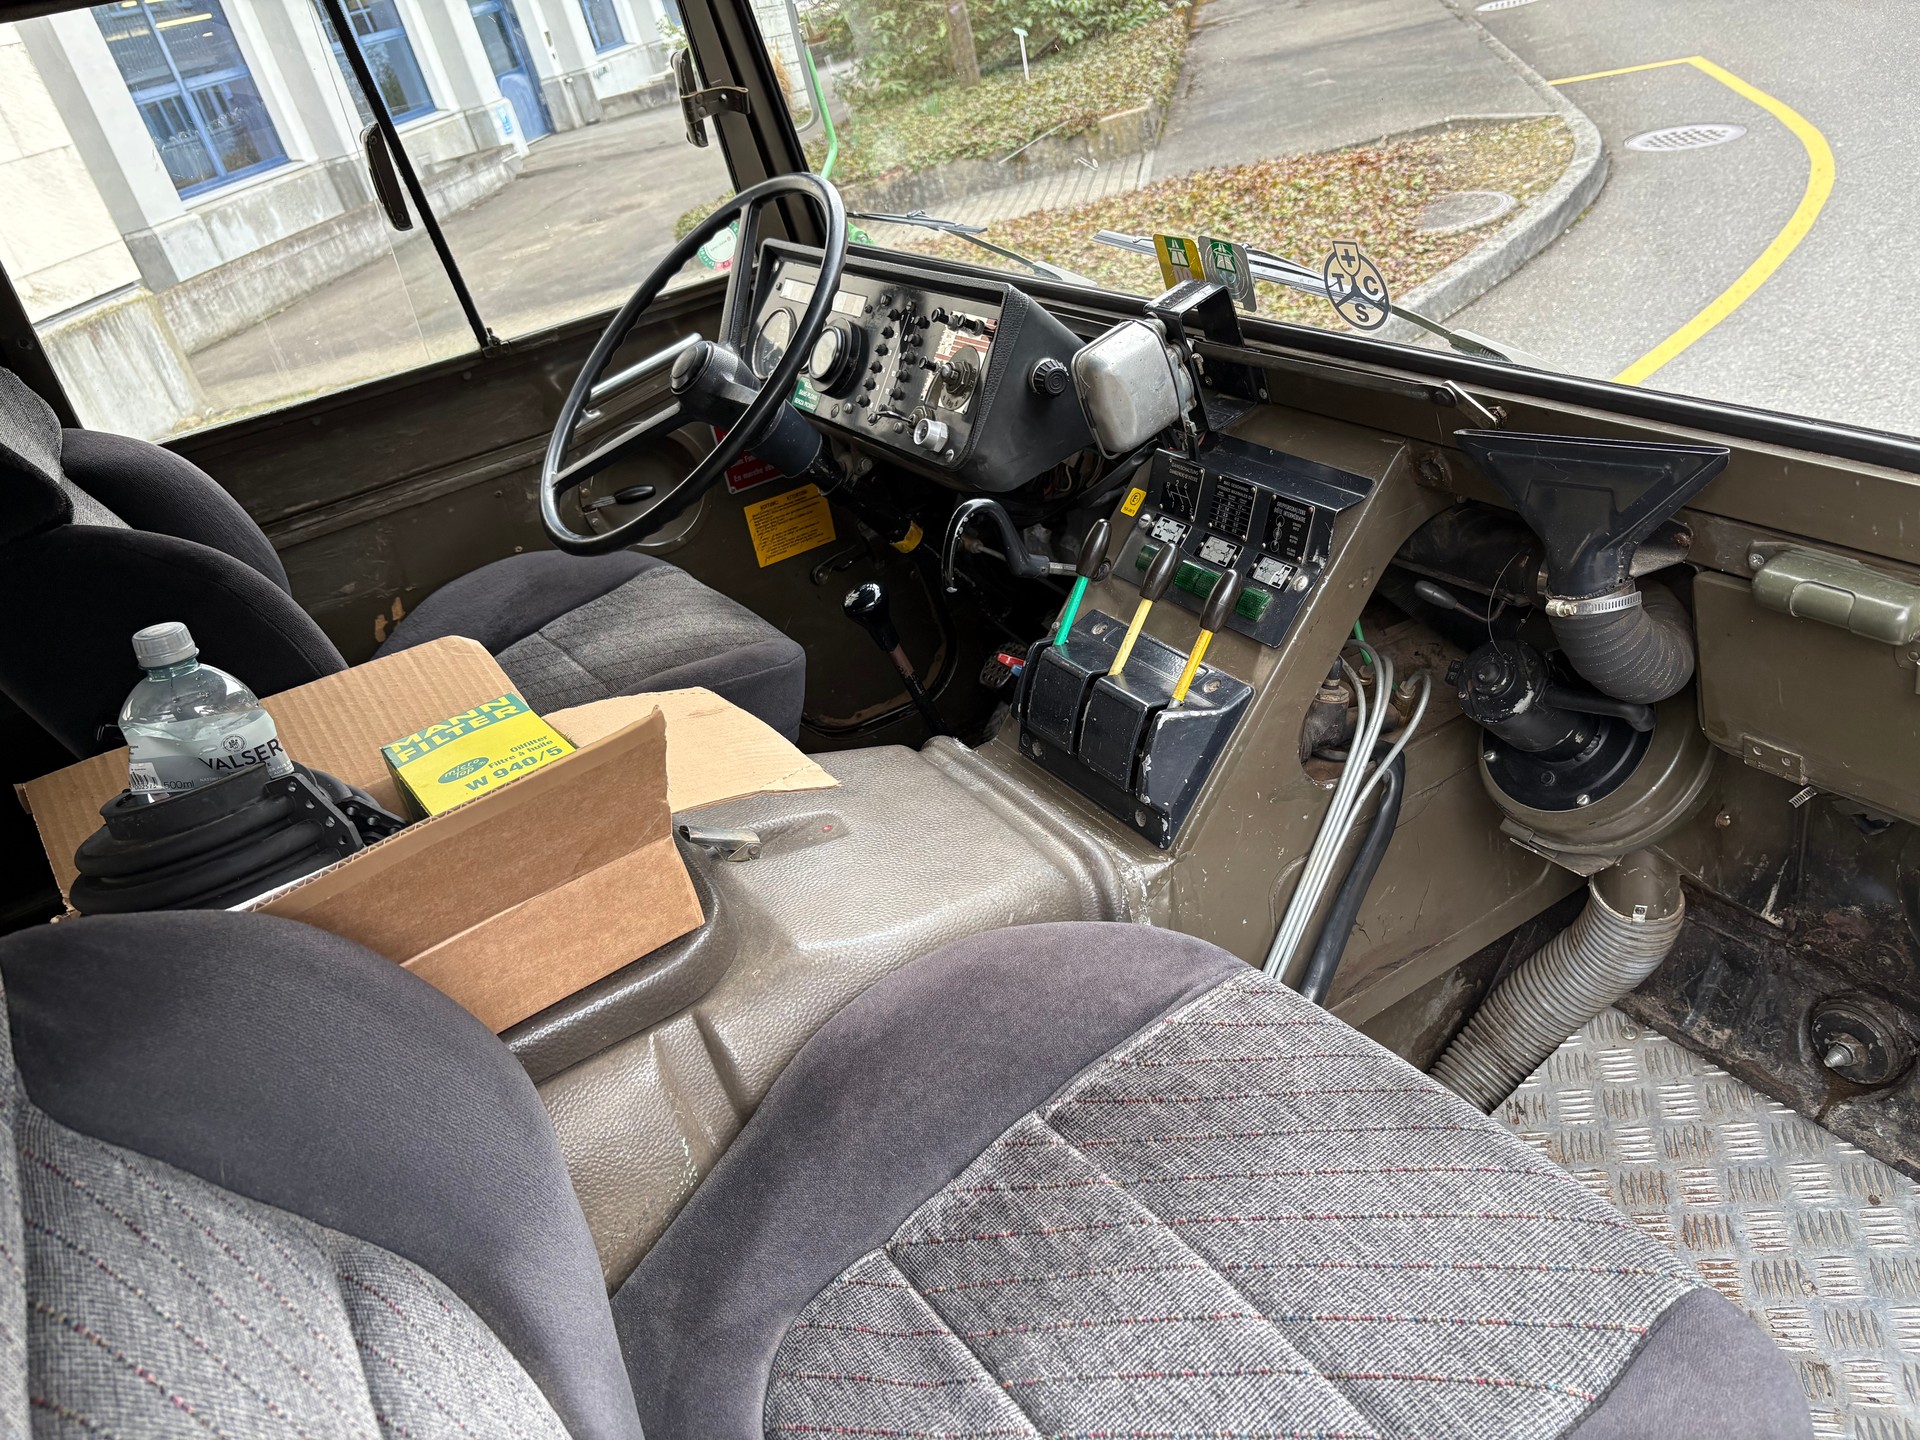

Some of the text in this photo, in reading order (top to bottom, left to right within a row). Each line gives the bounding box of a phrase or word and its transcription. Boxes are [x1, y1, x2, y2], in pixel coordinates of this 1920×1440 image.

[393, 696, 512, 754] MANN
[398, 706, 521, 763] FILTER
[198, 738, 284, 771] VALSER
[444, 758, 480, 778] micro
[465, 746, 564, 791] W 940/5
[488, 754, 515, 769] Filtre
[526, 739, 554, 754] huile
[163, 779, 196, 790] 500ml
